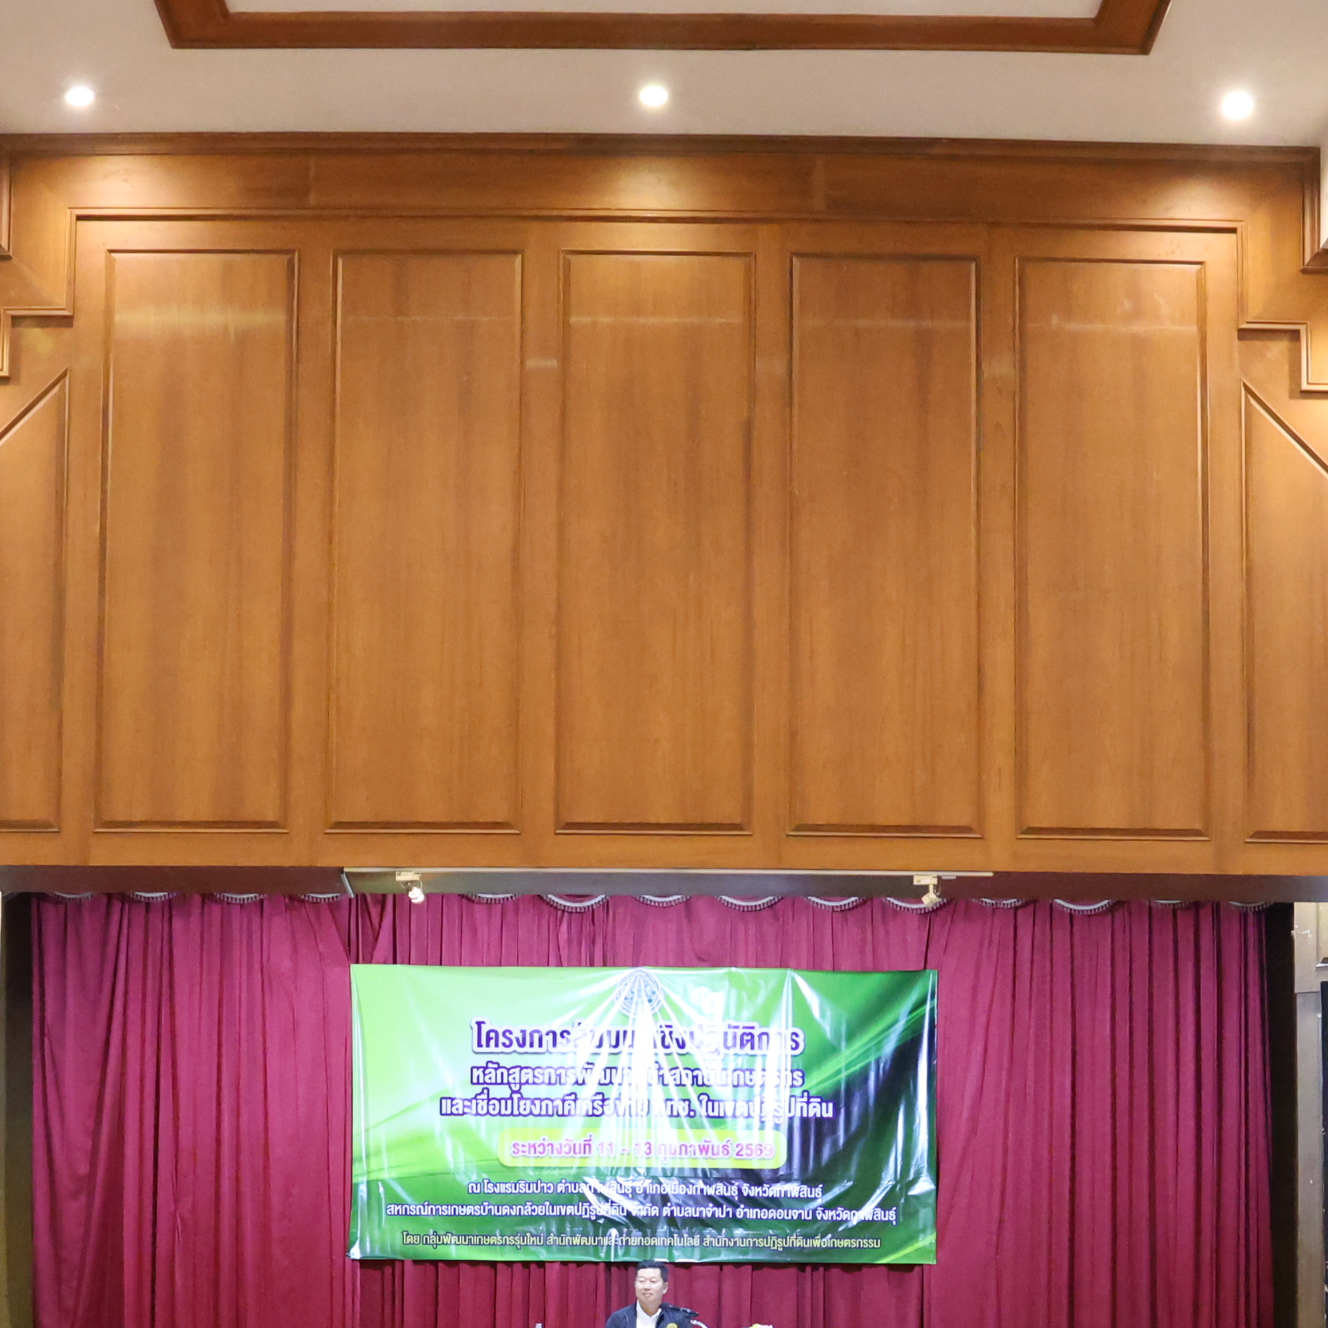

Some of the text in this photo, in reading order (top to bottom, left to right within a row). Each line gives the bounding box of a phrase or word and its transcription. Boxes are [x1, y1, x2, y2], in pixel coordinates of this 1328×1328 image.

[655, 1098, 697, 1118] ทช.
[511, 1134, 592, 1157] ระหว่างวันที่
[598, 1141, 615, 1157] 11
[634, 1141, 652, 1157] 13
[657, 1139, 732, 1162] กุมภาพันธ์
[735, 1143, 775, 1159] 2569
[482, 1179, 554, 1195] โรงแรมริมปาว
[402, 1231, 420, 1245] โดย
[422, 1231, 544, 1249] กลุ่มพัฒนาเกษตรกรรุ่นใหม่
